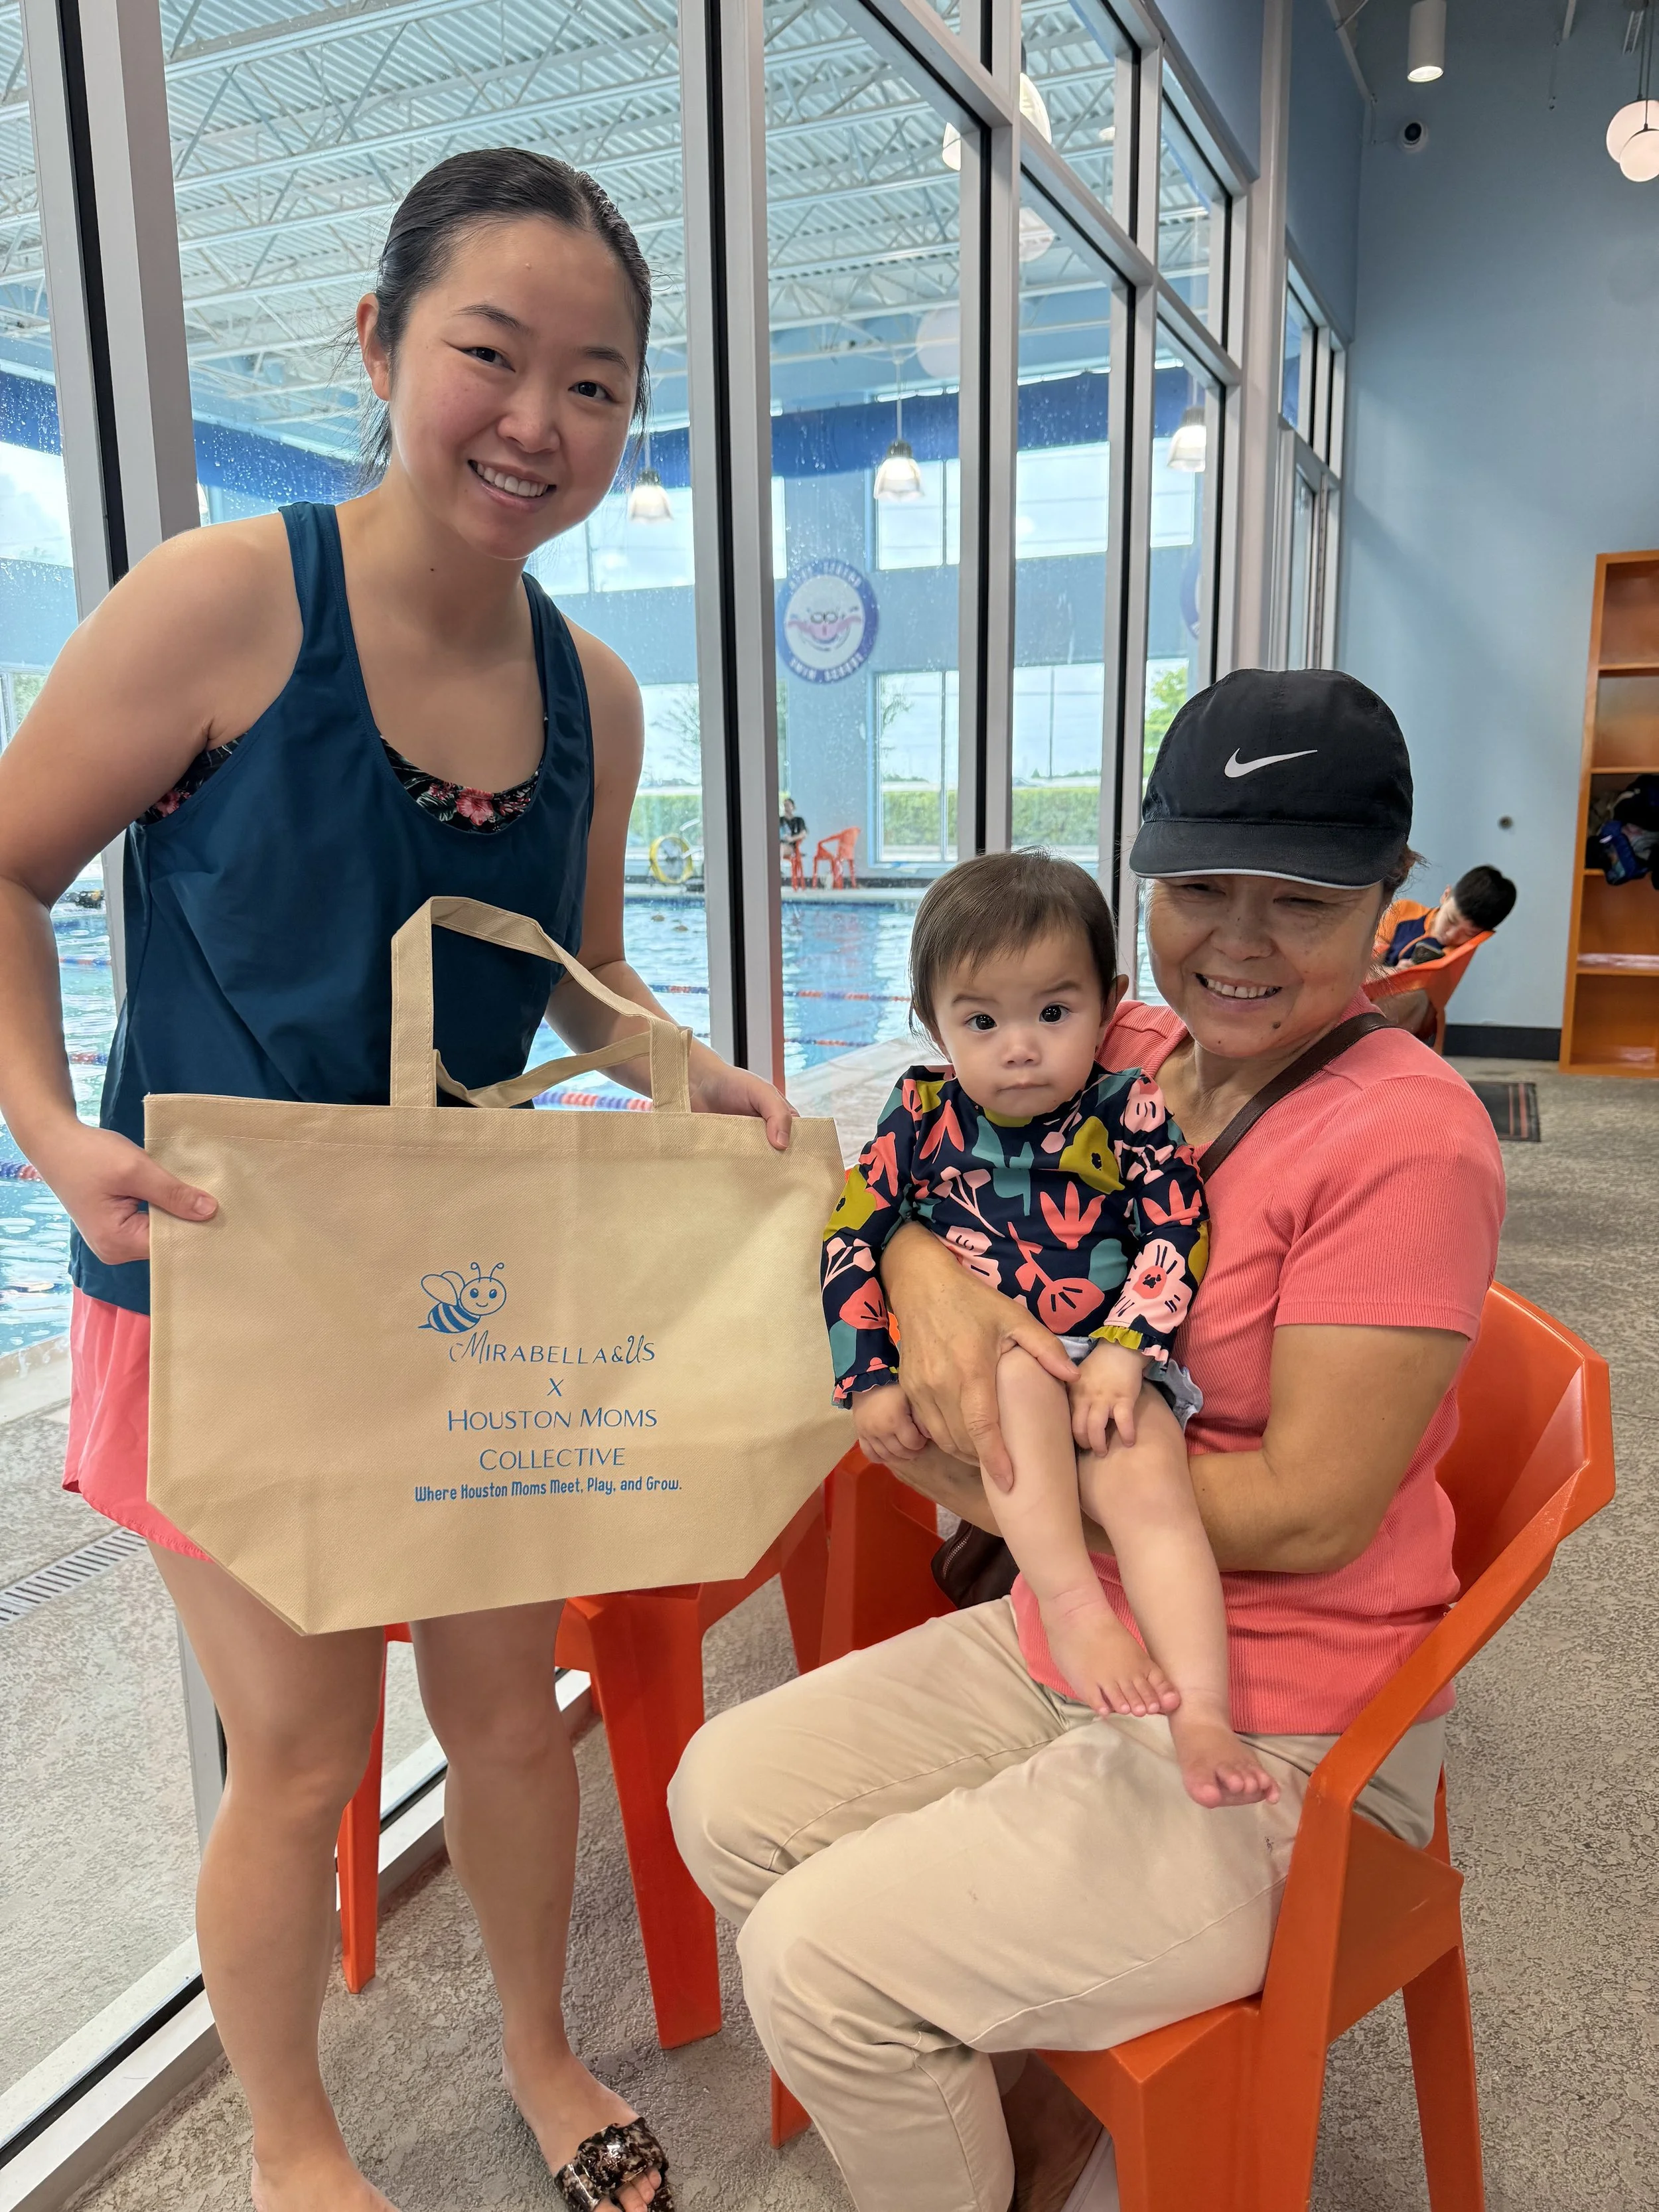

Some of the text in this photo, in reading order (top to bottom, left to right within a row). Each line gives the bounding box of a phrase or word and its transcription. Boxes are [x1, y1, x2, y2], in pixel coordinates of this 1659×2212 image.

[479, 1447, 626, 1471] COLLECTIVE
[414, 1486, 457, 1503] Where
[461, 1483, 508, 1499] Houston
[511, 1481, 547, 1497] Moms
[549, 1478, 583, 1495] Meet,
[620, 1476, 642, 1491] and
[646, 1475, 682, 1491] Grow.
